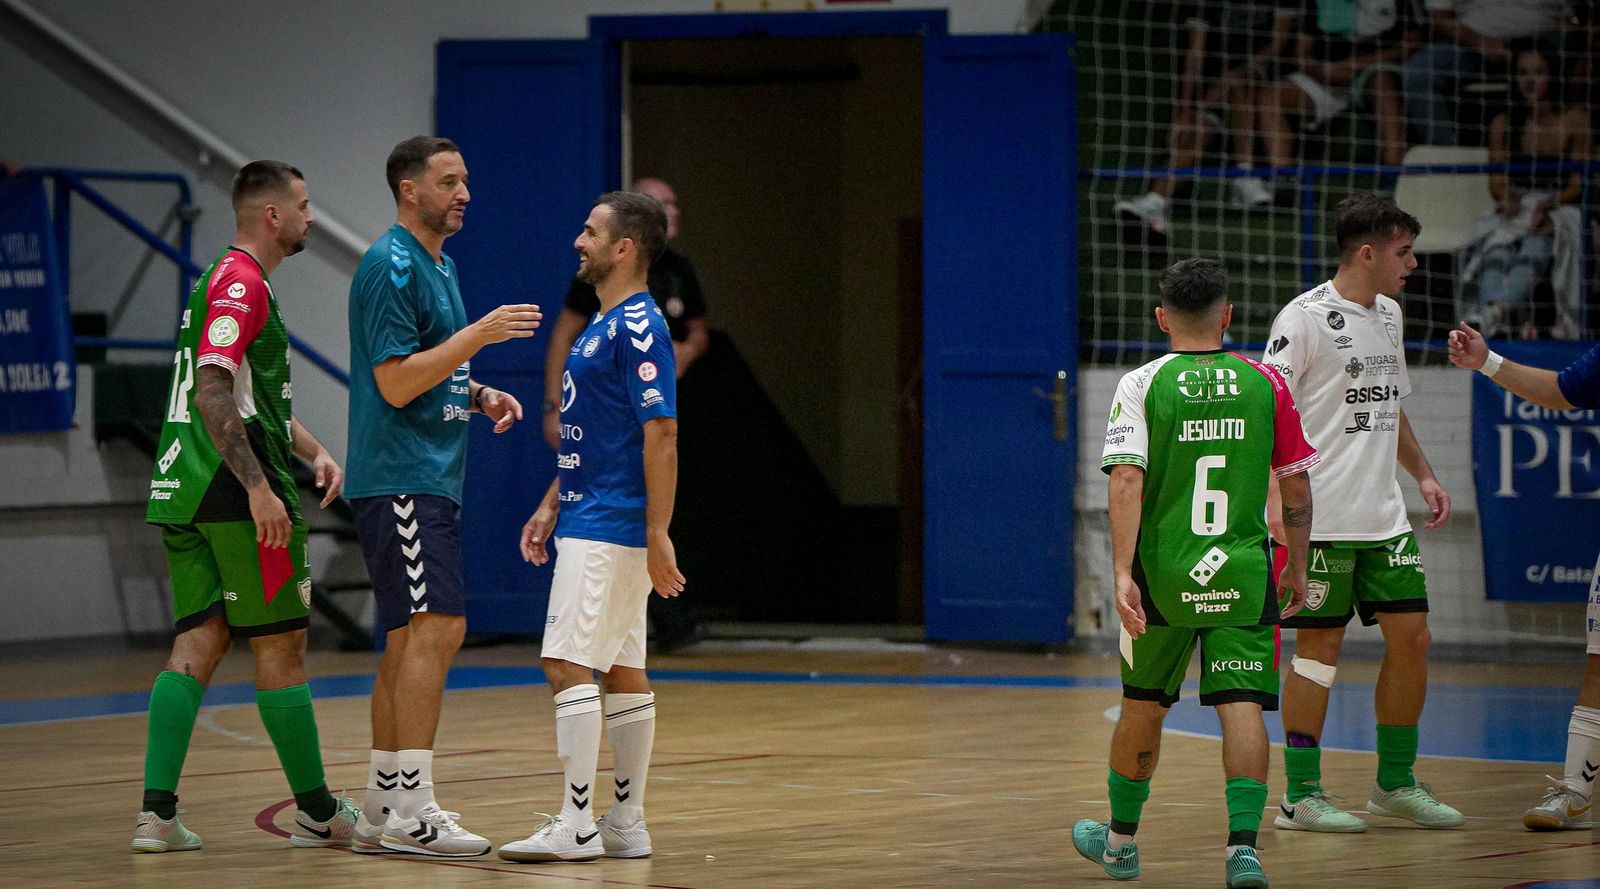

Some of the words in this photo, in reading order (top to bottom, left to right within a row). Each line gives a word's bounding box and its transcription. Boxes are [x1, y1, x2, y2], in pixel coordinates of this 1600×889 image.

[53, 361, 72, 391] 2
[1178, 418, 1245, 441] JESULITO
[1191, 455, 1228, 536] 6
[1181, 588, 1240, 603] Domino's
[1195, 603, 1230, 614] Pizza
[1211, 659, 1263, 672] Kraus
